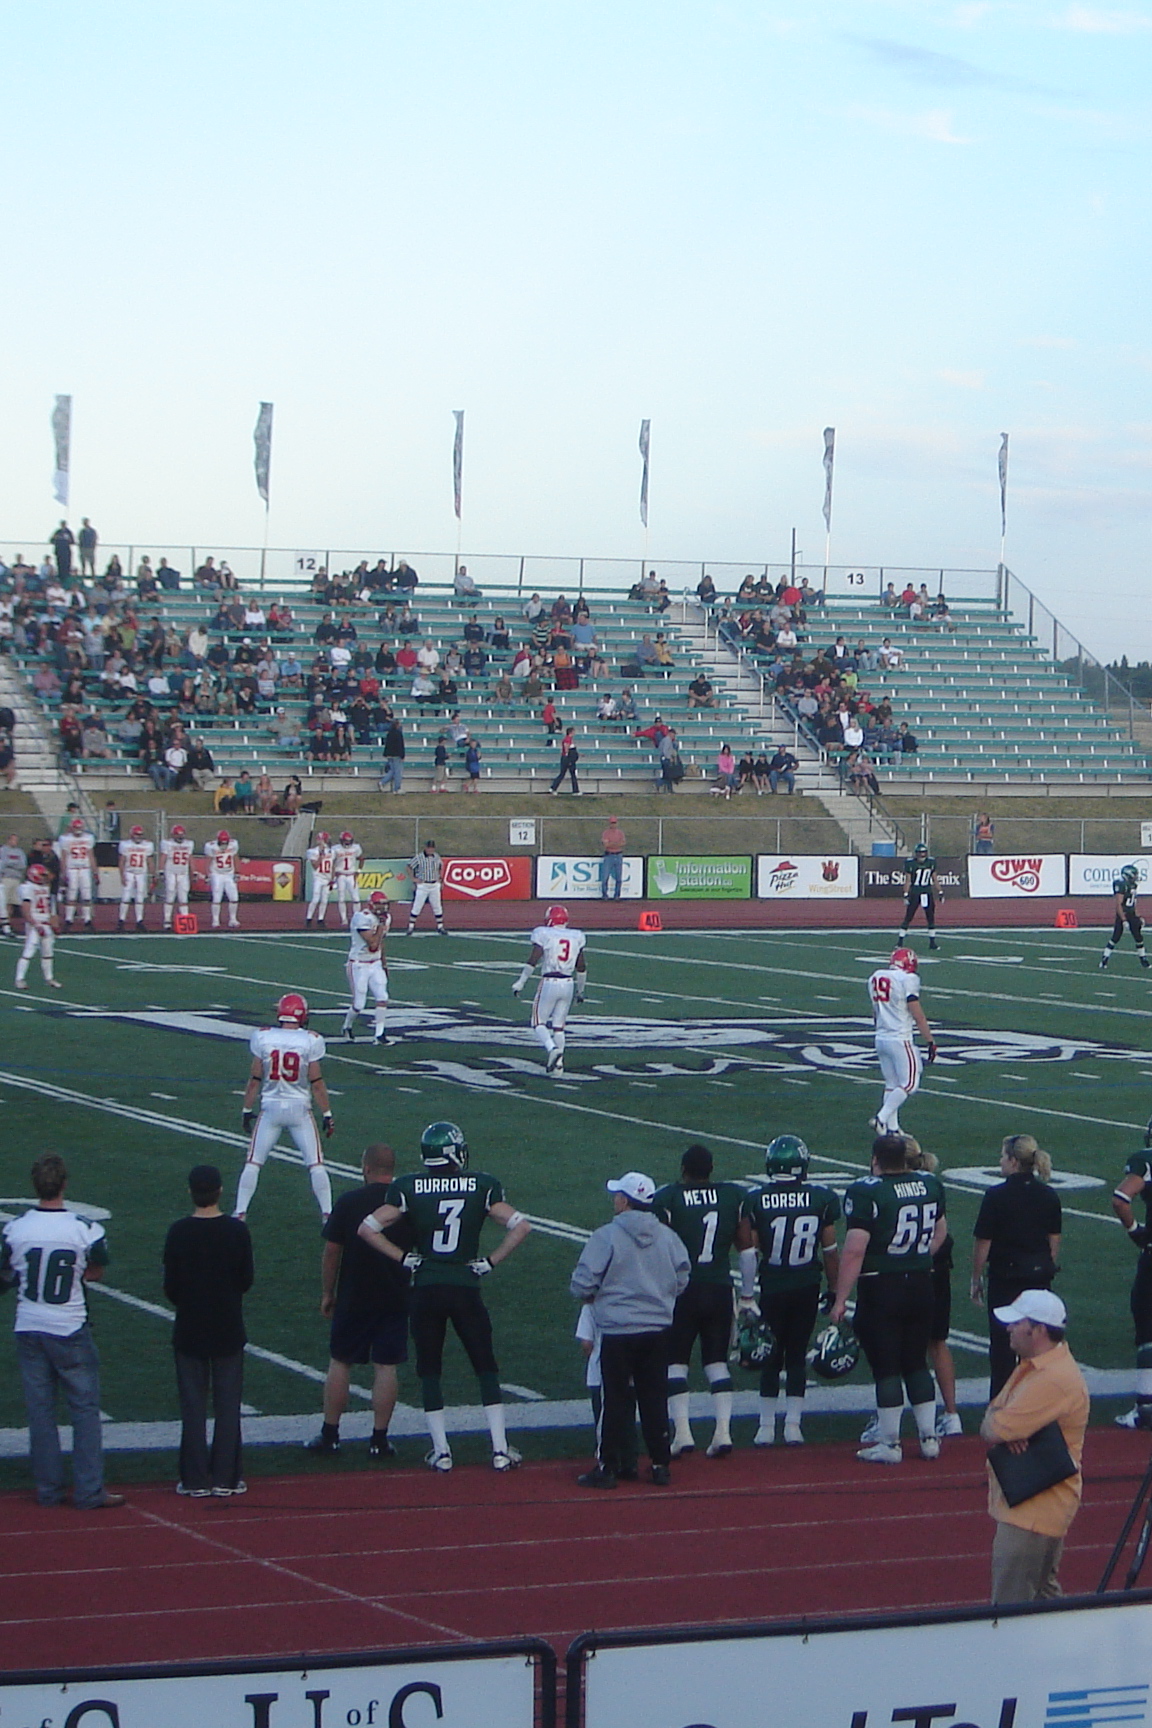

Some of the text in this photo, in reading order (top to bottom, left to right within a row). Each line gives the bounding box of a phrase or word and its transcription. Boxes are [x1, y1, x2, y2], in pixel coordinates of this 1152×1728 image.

[297, 558, 316, 570] 12
[847, 573, 865, 585] 13
[518, 831, 529, 841] 12
[130, 854, 144, 868] 61
[173, 852, 188, 865] 65
[216, 855, 232, 868] 54
[343, 858, 349, 870] 1
[319, 860, 331, 873] 10
[676, 862, 748, 875] Information
[356, 869, 393, 889] WAY
[769, 872, 799, 888] Pizza
[865, 871, 890, 885] The
[913, 869, 934, 886] 10
[1083, 867, 1148, 882] cones
[775, 880, 796, 892] Hut
[178, 917, 196, 932] 50
[645, 914, 660, 927] 40
[1062, 912, 1077, 925] 30
[558, 939, 571, 962] 3
[269, 1050, 301, 1082] 19
[414, 1177, 477, 1195] BURROWS
[893, 1181, 928, 1200] HINDS
[682, 1188, 719, 1207] METU
[761, 1192, 811, 1210] GORSKI
[432, 1198, 466, 1253] 3
[887, 1202, 938, 1255] 65
[697, 1211, 719, 1264] 1
[767, 1215, 820, 1267] 18
[24, 1247, 77, 1305] 16
[347, 1700, 380, 1726] of
